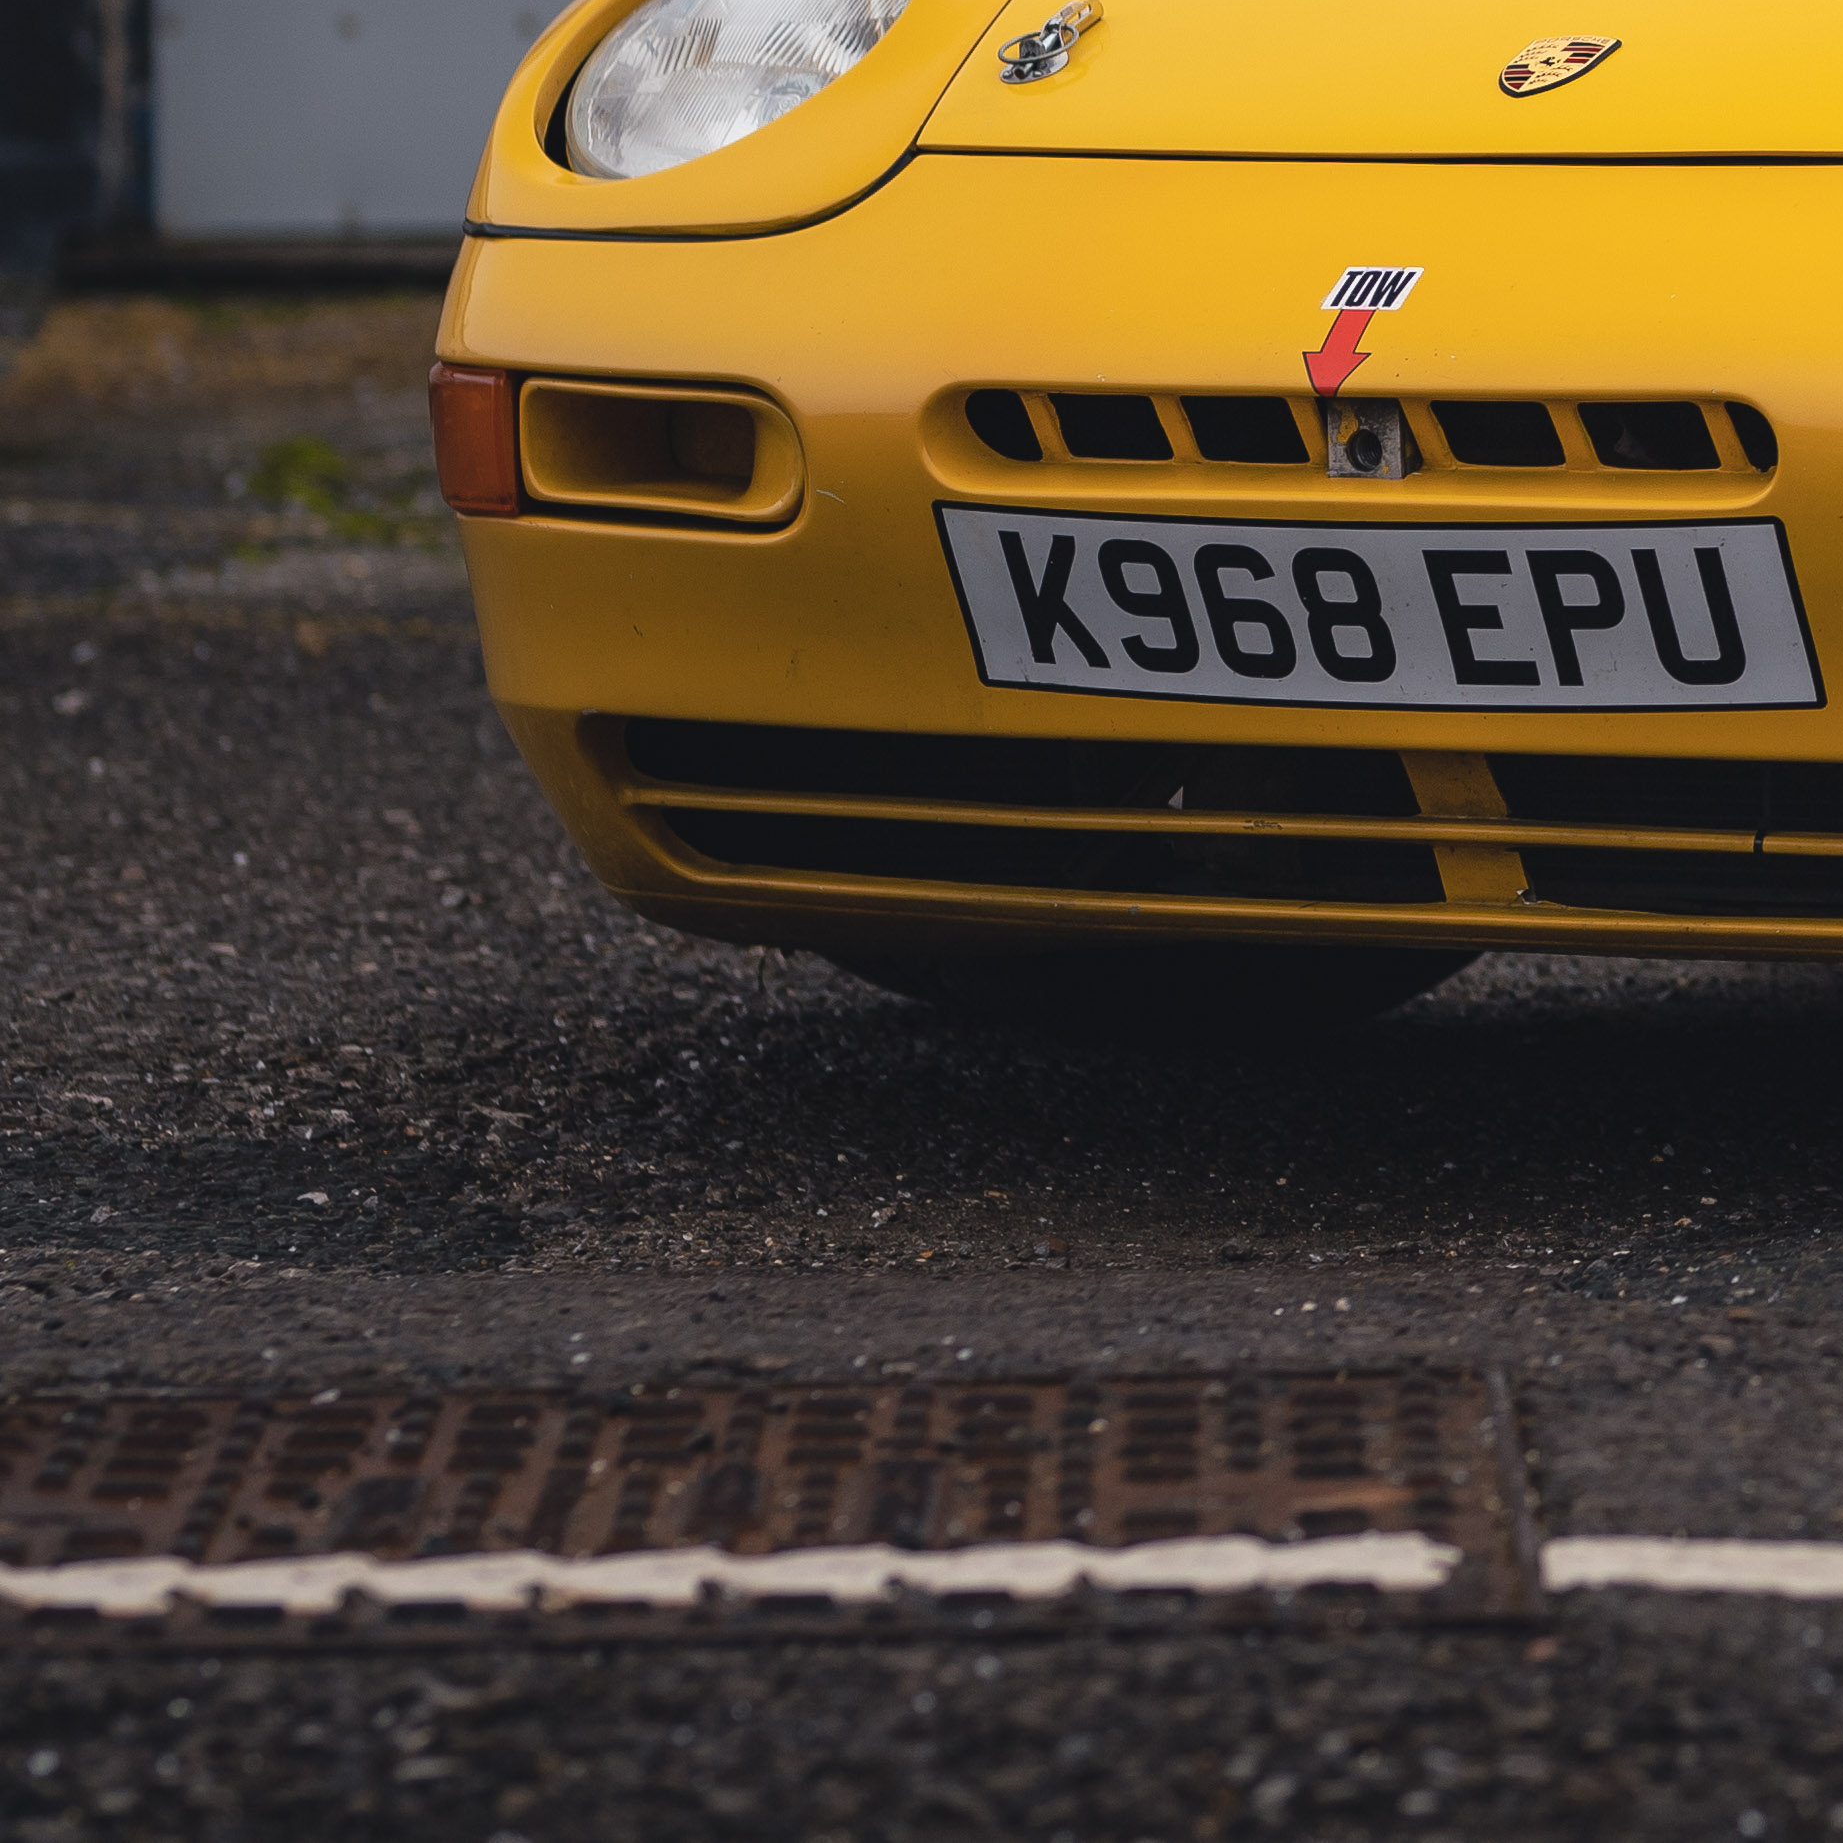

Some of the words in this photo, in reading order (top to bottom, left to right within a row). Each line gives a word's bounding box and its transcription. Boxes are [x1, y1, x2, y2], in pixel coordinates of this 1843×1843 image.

[1534, 36, 1611, 45] PORSCHE
[1330, 270, 1417, 308] TOW
[998, 529, 1398, 684] K968
[1421, 545, 1747, 687] EPU
